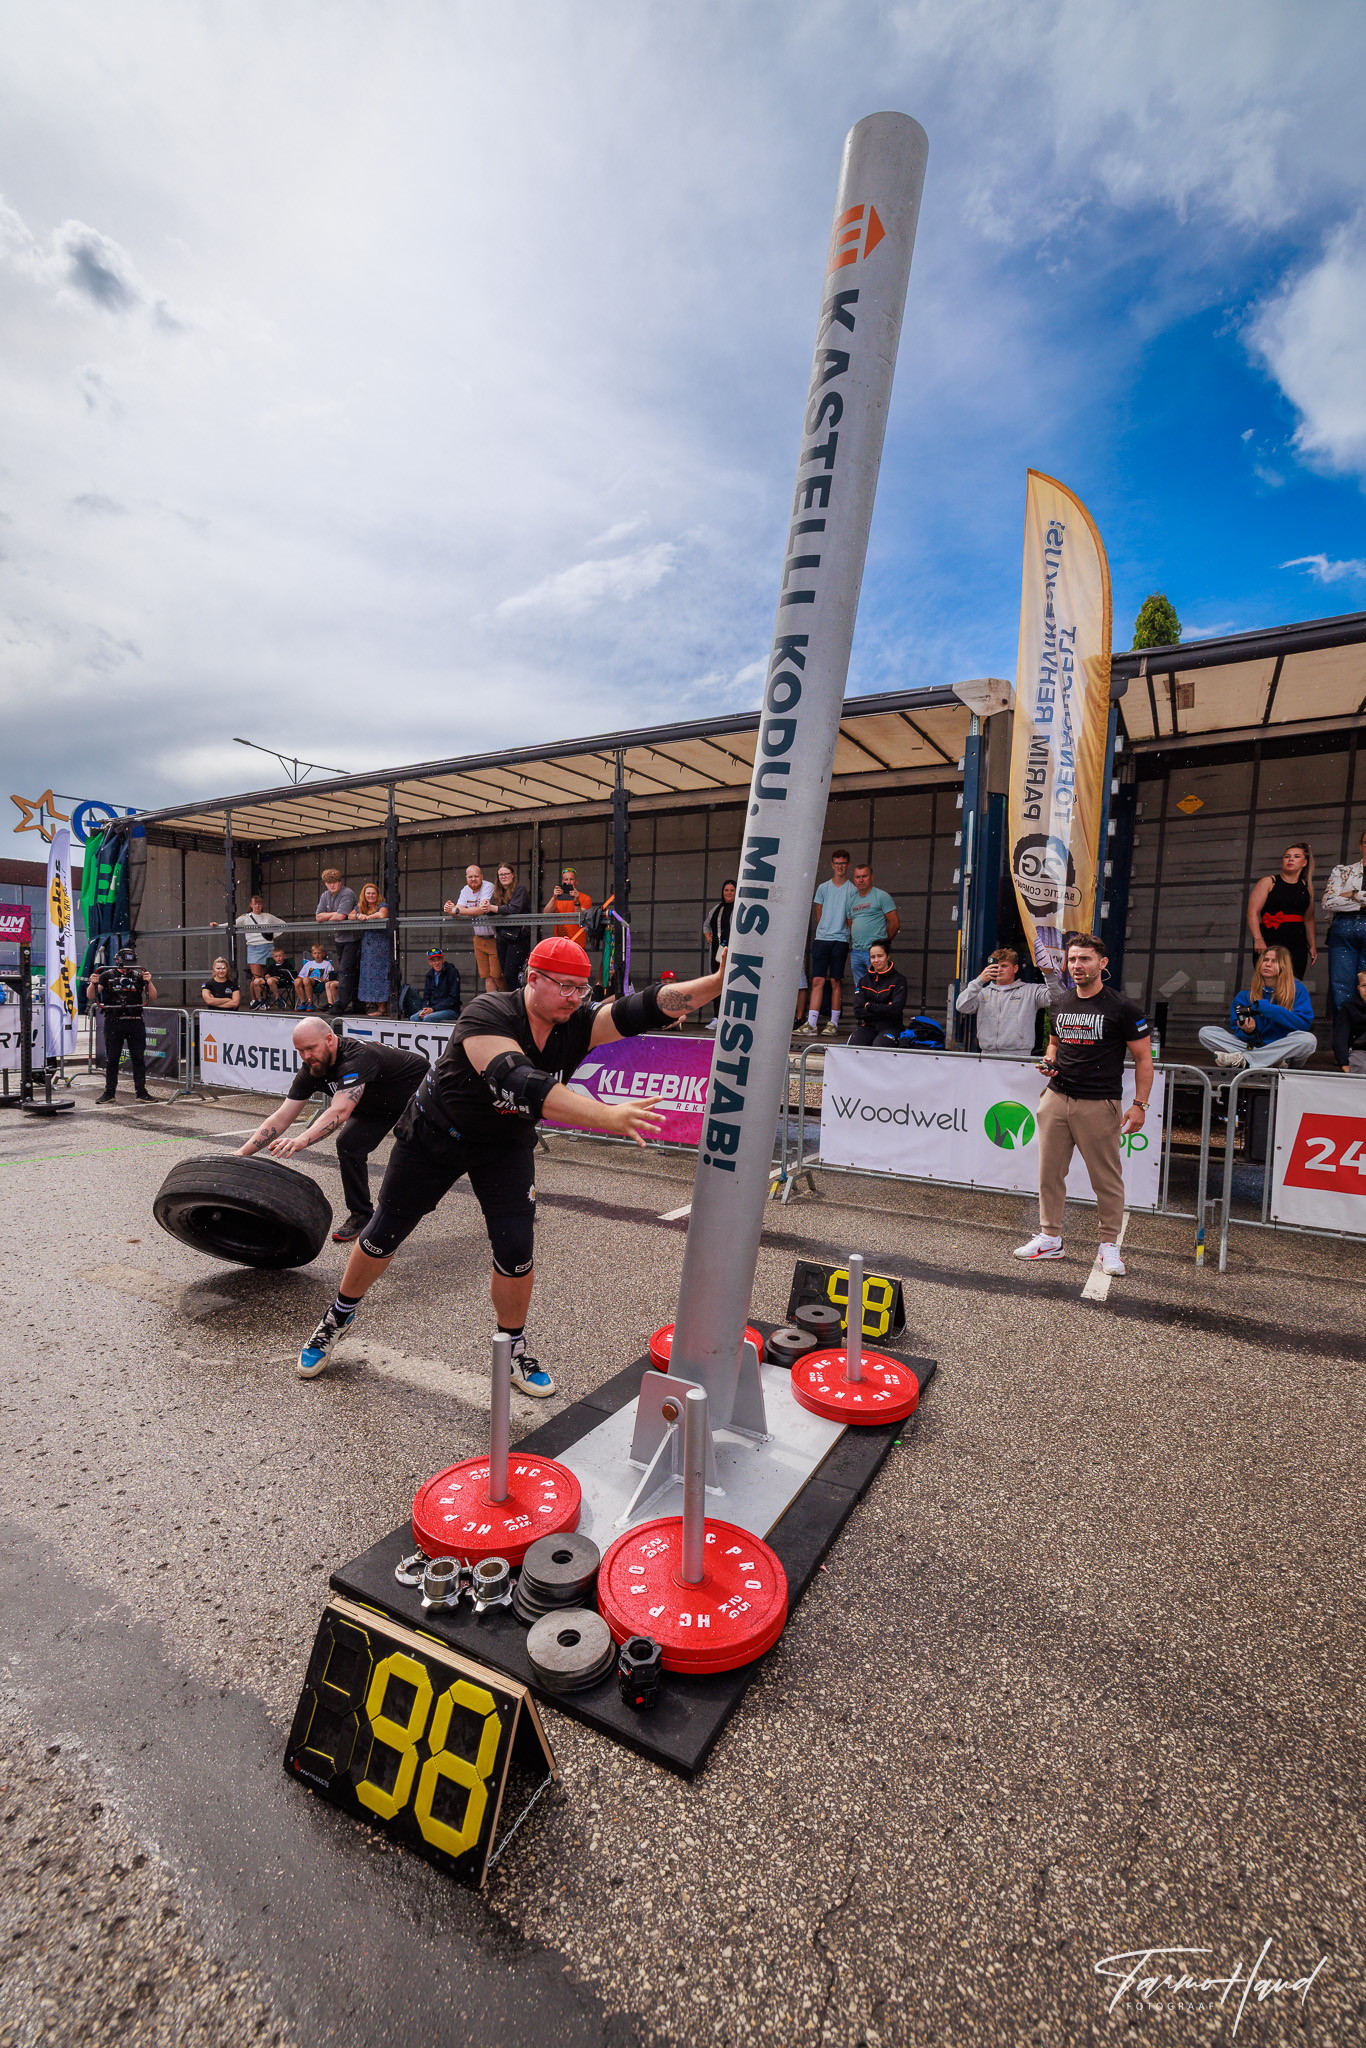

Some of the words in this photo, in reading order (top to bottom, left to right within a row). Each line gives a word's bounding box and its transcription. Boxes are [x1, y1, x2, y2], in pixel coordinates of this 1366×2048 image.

[780, 289, 859, 608] KASTELLI
[751, 634, 809, 816] KODU.
[736, 836, 780, 935] MIS
[703, 954, 762, 1172] KESTAB!
[597, 1069, 709, 1102] KLEEBIK
[831, 1094, 969, 1132] Woodwell
[439, 1483, 463, 1523] PRO
[514, 1465, 541, 1478] HC
[537, 1479, 558, 1514] PRO
[462, 1521, 492, 1536] HC
[649, 1538, 670, 1553] 25
[639, 1543, 658, 1559] KG
[725, 1545, 763, 1590] PRO
[628, 1564, 666, 1618] PRO
[717, 1602, 741, 1620] KG
[728, 1594, 753, 1613] 25
[679, 1612, 711, 1628] HC
[355, 1651, 502, 1858] 98
